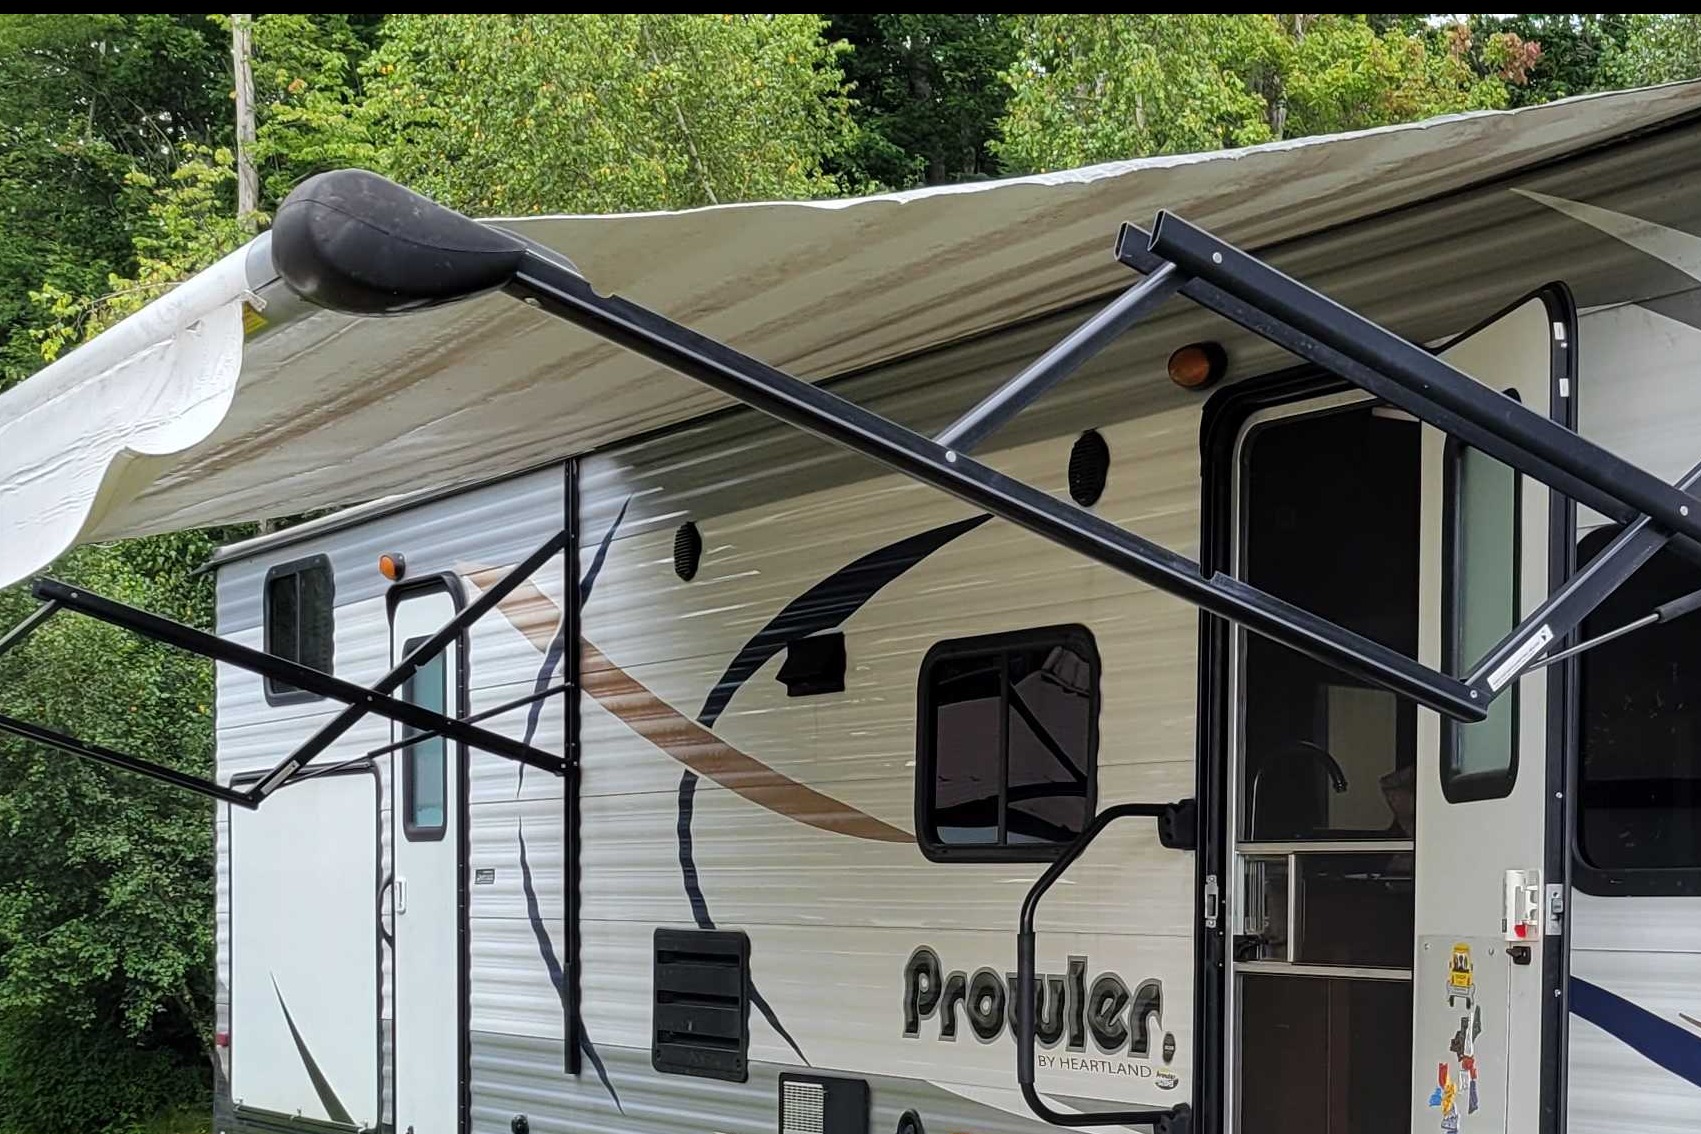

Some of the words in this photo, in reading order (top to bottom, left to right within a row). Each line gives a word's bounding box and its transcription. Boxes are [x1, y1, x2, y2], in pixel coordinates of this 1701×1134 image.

[902, 945, 1163, 1058] Prowler
[1038, 1055, 1055, 1068] BY
[1060, 1058, 1152, 1078] HEARTLAND
